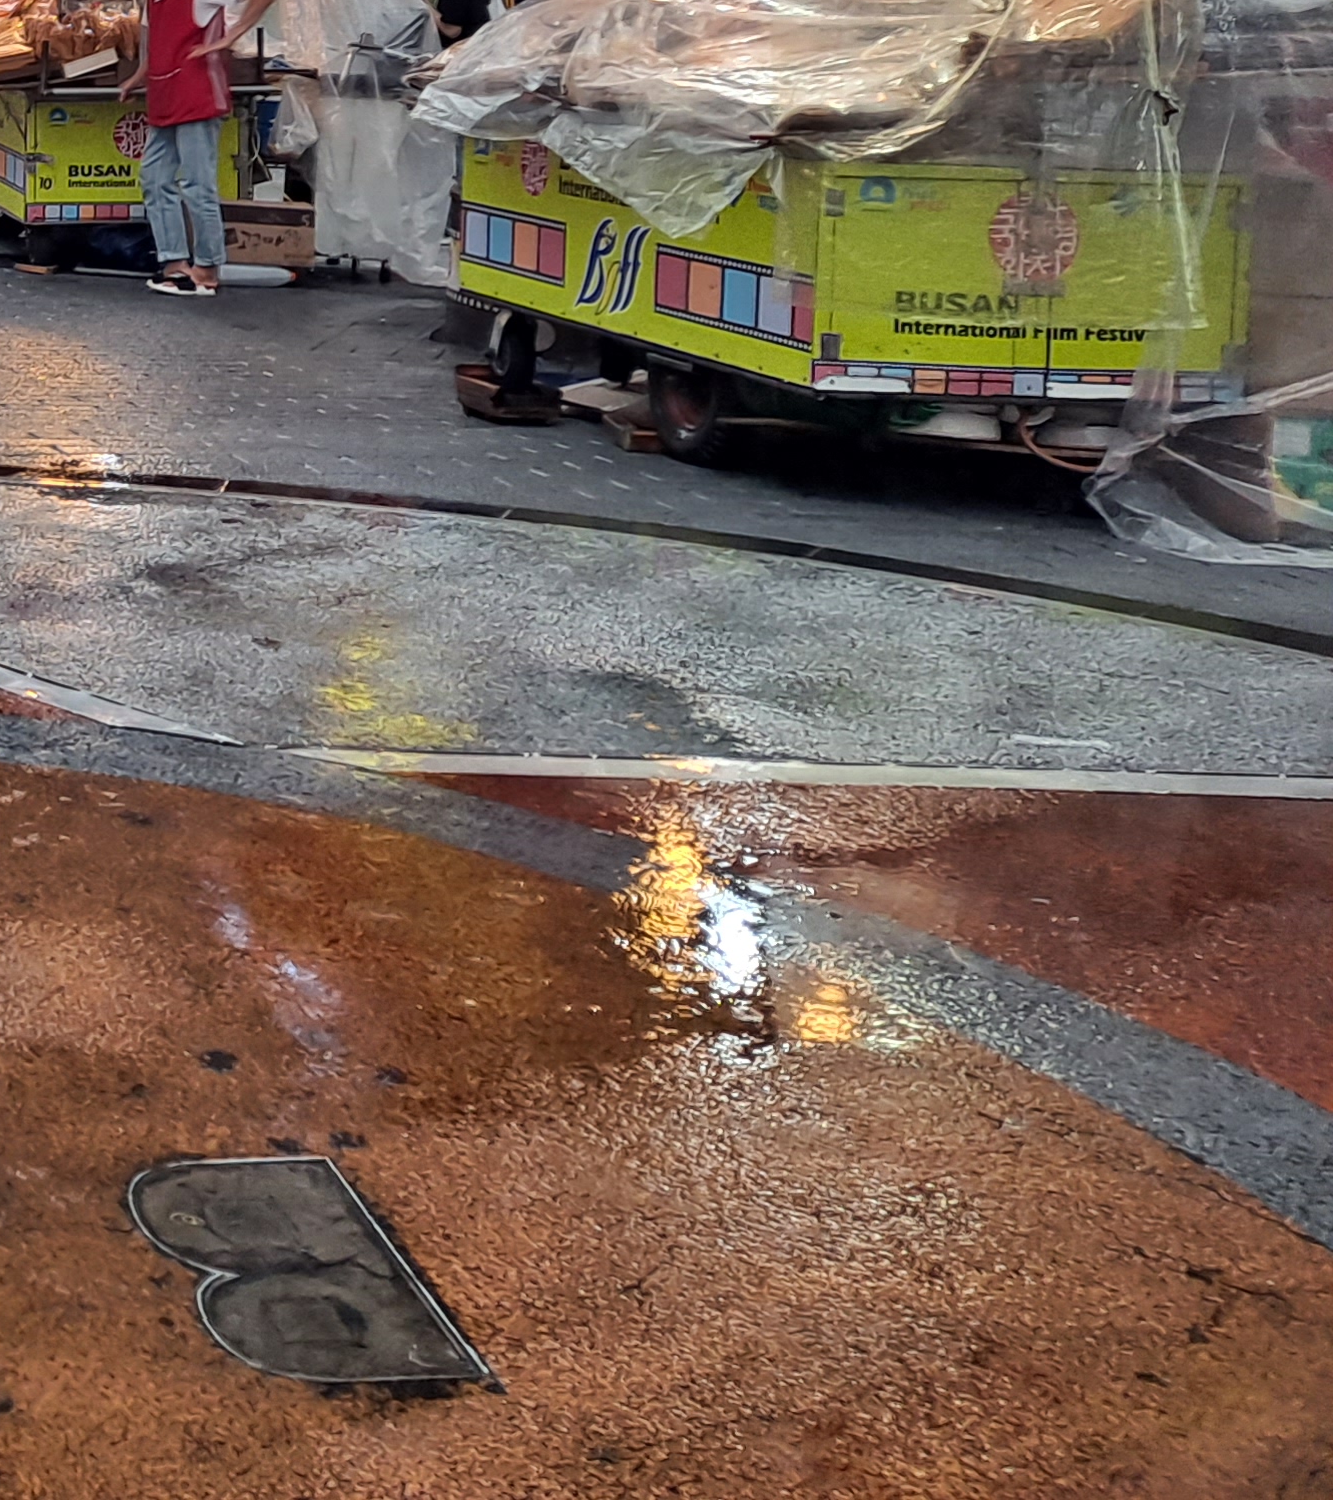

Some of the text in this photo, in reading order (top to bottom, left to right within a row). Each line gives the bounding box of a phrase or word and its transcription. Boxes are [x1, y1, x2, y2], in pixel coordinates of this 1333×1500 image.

[67, 164, 132, 177] BUSAN
[39, 177, 136, 190] 10 International
[894, 290, 1020, 316] BUSAN
[893, 318, 1026, 341] International
[1084, 325, 1146, 343] Festiv
